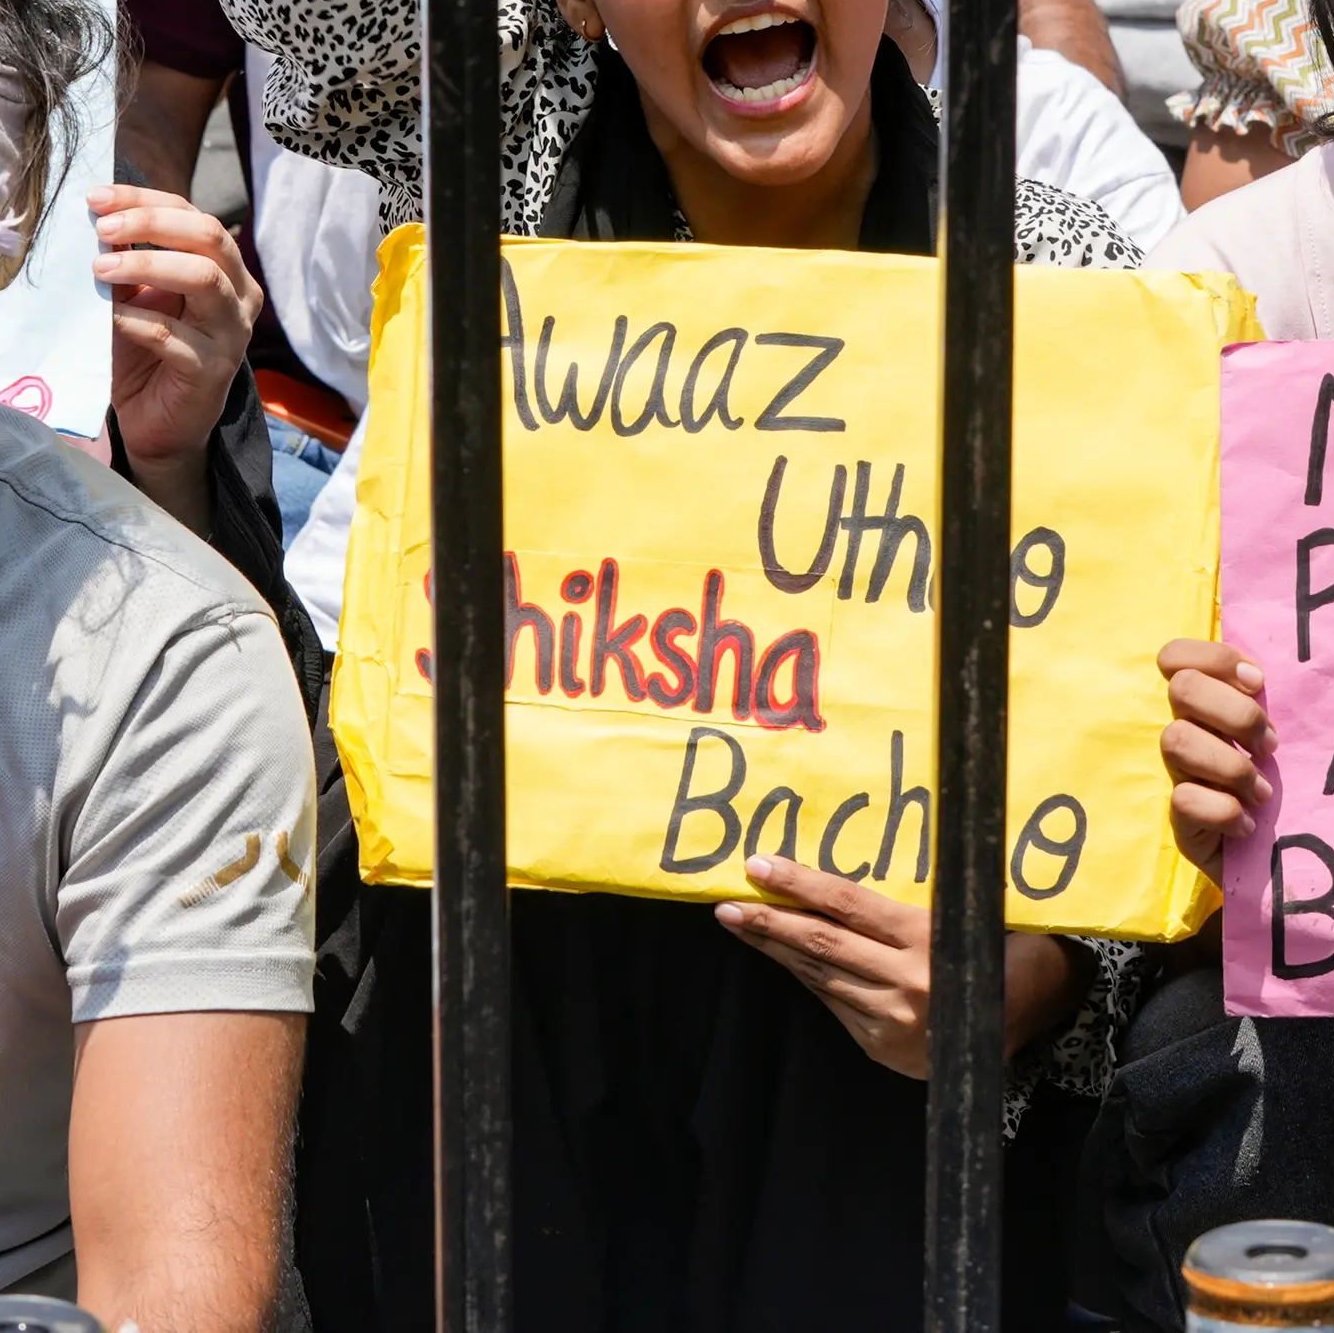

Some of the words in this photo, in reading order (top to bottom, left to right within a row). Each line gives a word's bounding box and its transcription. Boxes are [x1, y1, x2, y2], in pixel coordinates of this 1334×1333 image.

[757, 454, 1066, 629] Utho
[415, 550, 828, 733] hiksha
[659, 726, 1088, 902] Bacho
